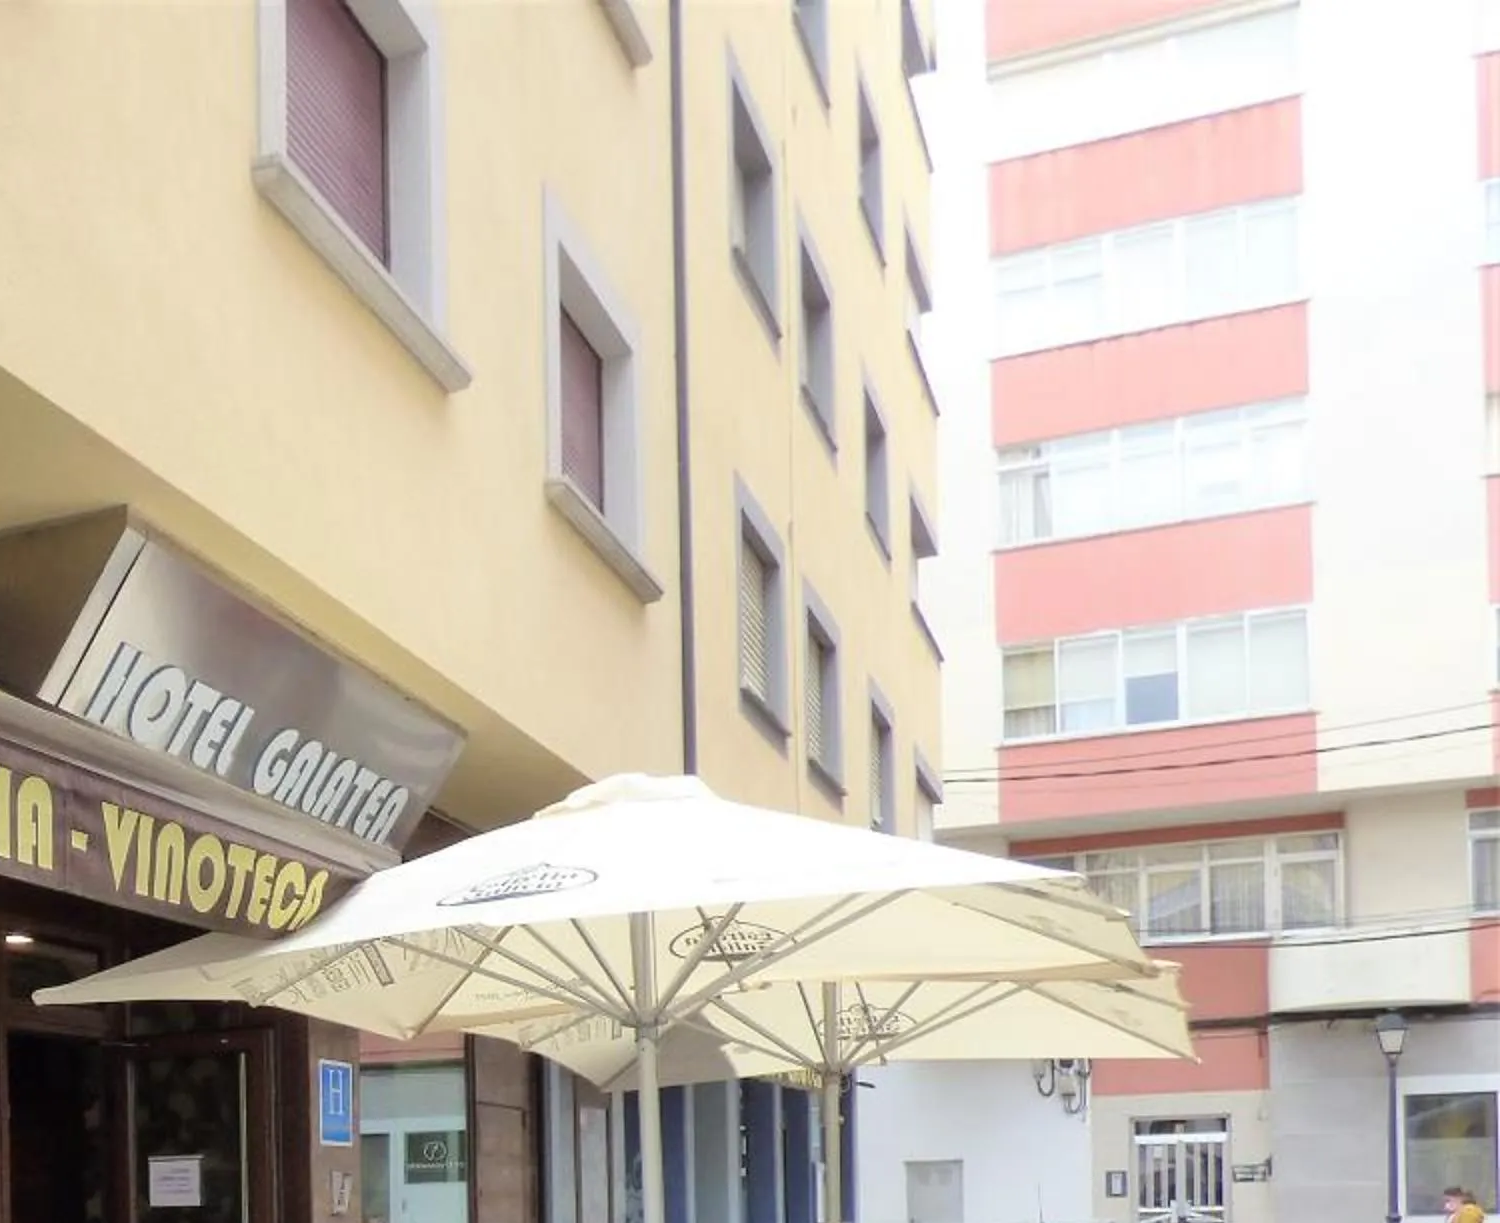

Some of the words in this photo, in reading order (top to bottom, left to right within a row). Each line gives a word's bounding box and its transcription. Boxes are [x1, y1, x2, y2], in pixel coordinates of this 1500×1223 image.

[84, 641, 255, 775] HOTEL
[251, 728, 410, 844] GALATEA
[100, 801, 331, 931] VINOTECA
[325, 1069, 345, 1115] H
